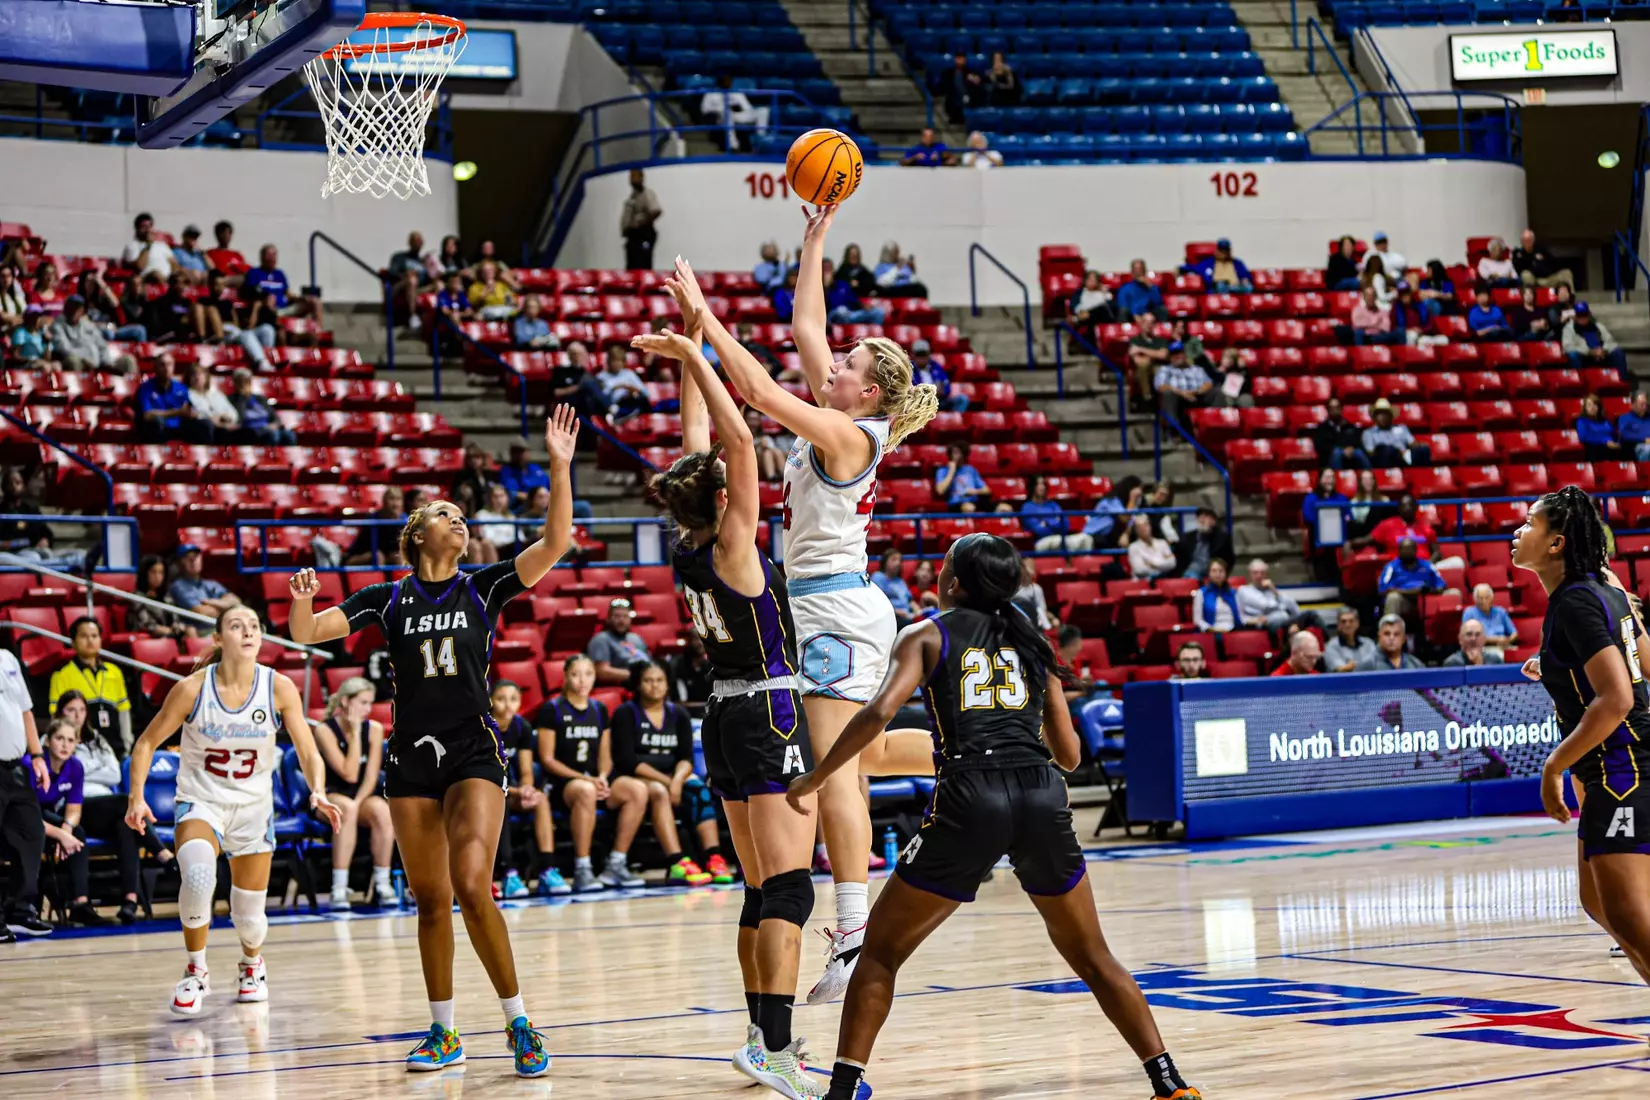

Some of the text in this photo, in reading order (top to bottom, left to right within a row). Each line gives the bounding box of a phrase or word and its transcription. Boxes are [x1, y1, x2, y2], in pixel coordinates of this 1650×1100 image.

[1461, 39, 1606, 71] Super 1 Foods
[745, 172, 789, 199] 101
[825, 170, 847, 203] NCAA
[1209, 172, 1258, 197] 102
[403, 611, 468, 635] LSUA
[684, 583, 733, 642] 34
[419, 636, 458, 678] 14
[960, 646, 1029, 712] 23
[576, 740, 589, 762] 2
[1269, 715, 1562, 762] North Louisiana Orthopaedi
[204, 748, 258, 779] 23
